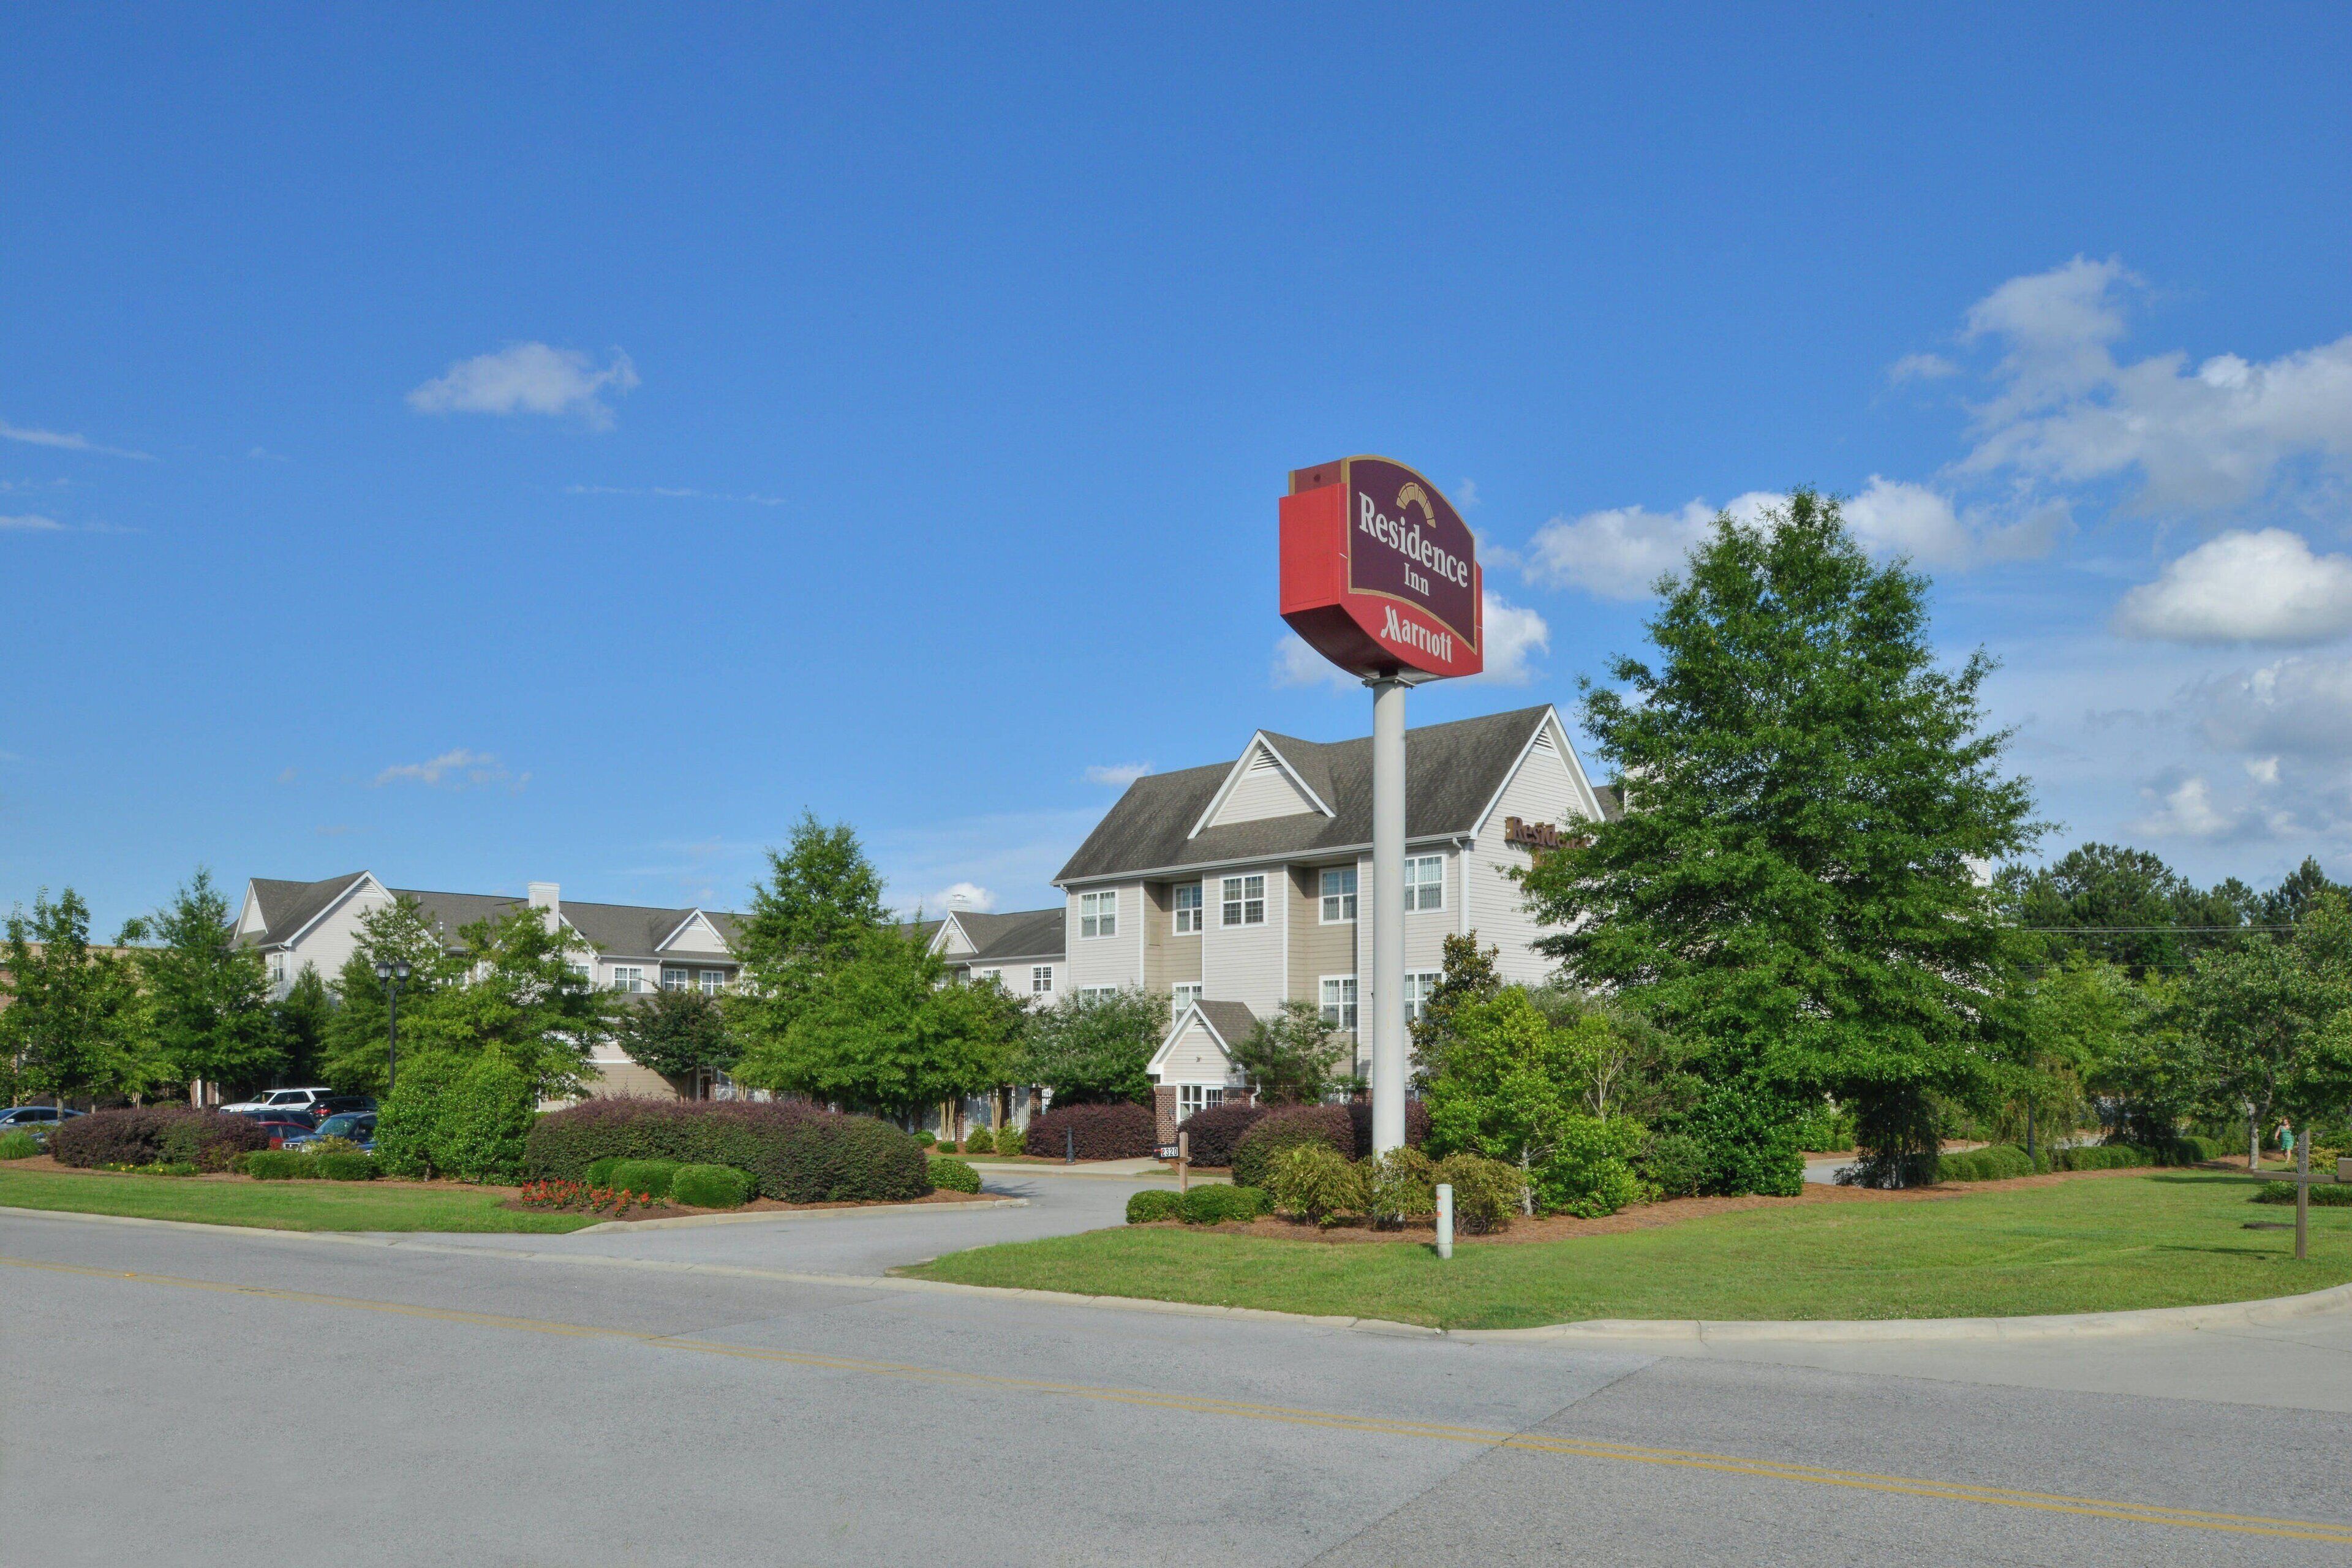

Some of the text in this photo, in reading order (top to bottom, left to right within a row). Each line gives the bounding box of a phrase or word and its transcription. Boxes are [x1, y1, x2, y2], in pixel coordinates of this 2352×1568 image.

[1359, 491, 1468, 588] Residence
[1404, 562, 1430, 596] Inn
[1381, 605, 1452, 663] Marriott
